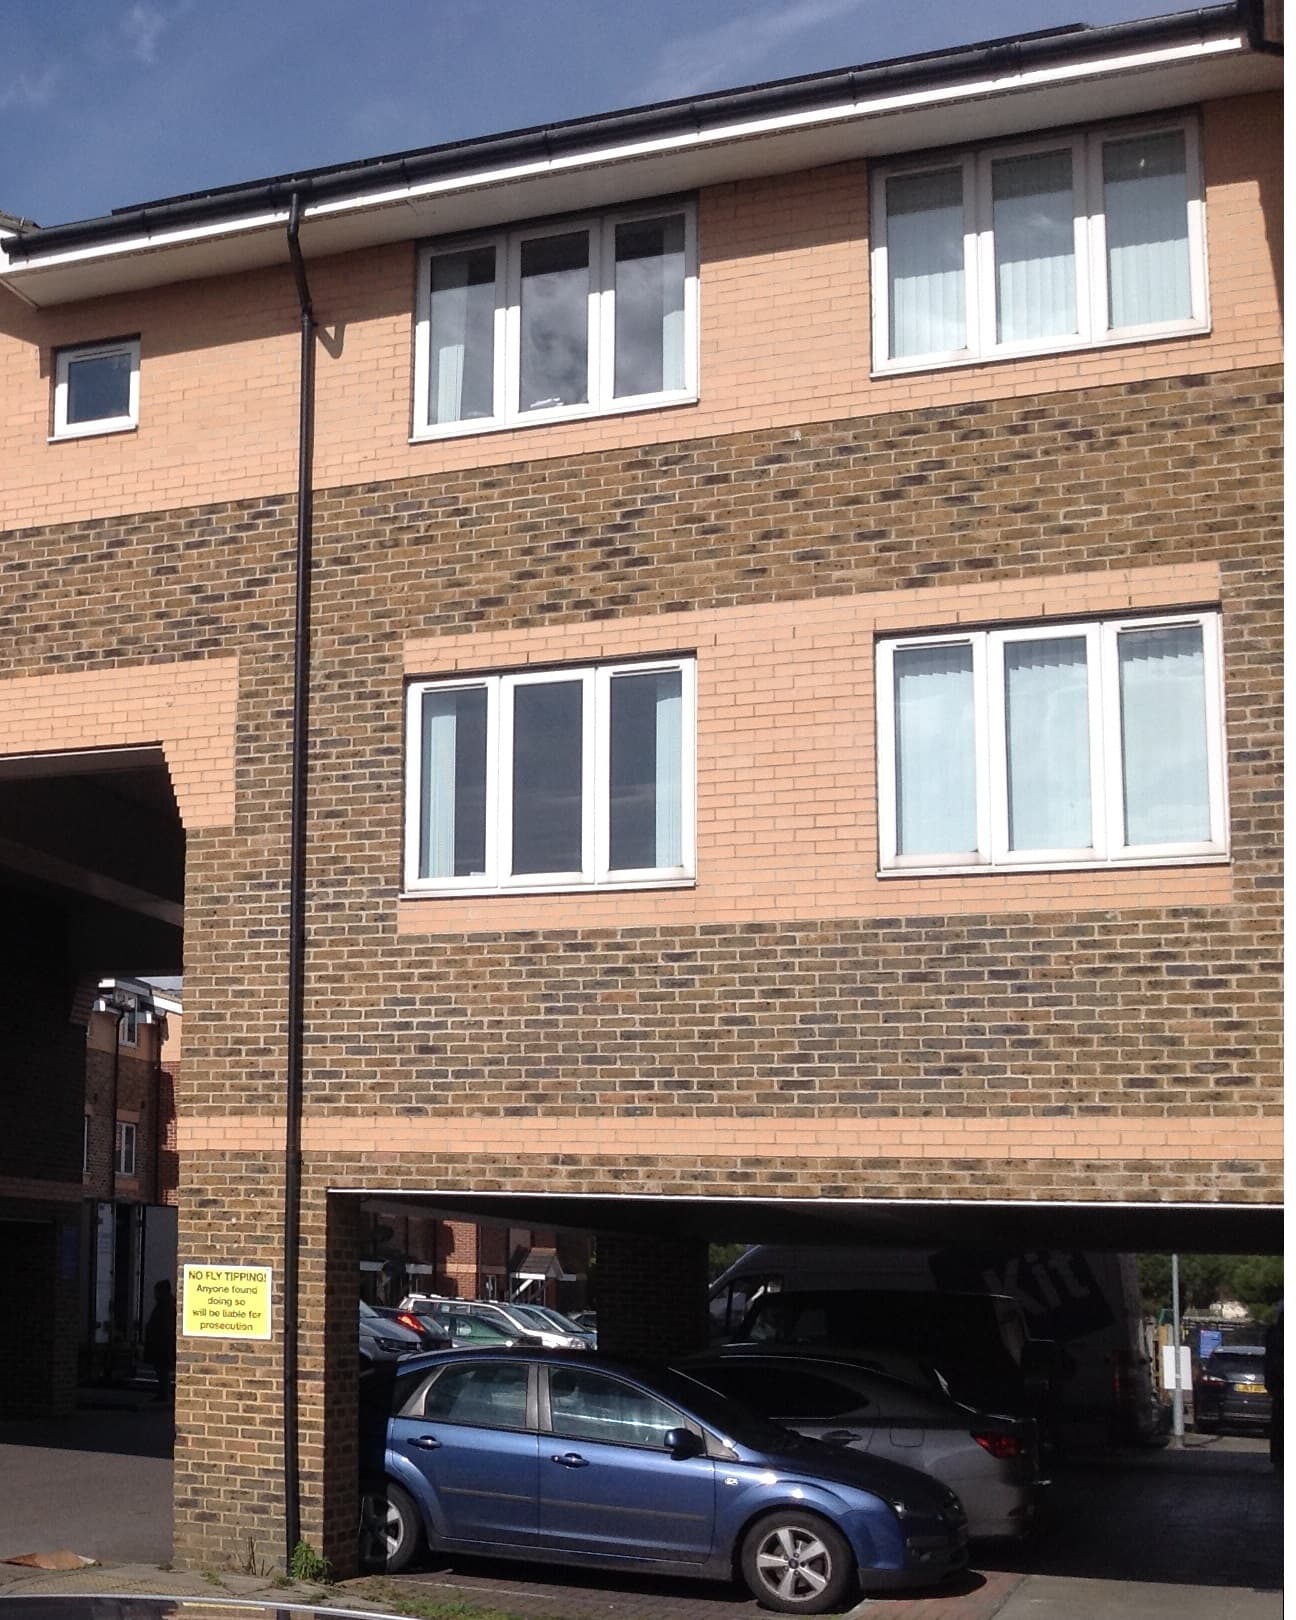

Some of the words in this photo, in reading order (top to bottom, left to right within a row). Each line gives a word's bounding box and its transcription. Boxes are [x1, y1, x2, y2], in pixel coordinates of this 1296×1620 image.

[188, 1271, 203, 1280] NO
[206, 1271, 222, 1281] FLY
[225, 1272, 267, 1282] TIPPING!
[196, 1284, 229, 1294] Anyone
[232, 1286, 258, 1294] found
[207, 1297, 232, 1307] doing
[193, 1308, 207, 1317] will
[209, 1309, 220, 1317] be
[222, 1309, 246, 1318] liable
[249, 1310, 262, 1319] for
[200, 1321, 253, 1331] prosecution
